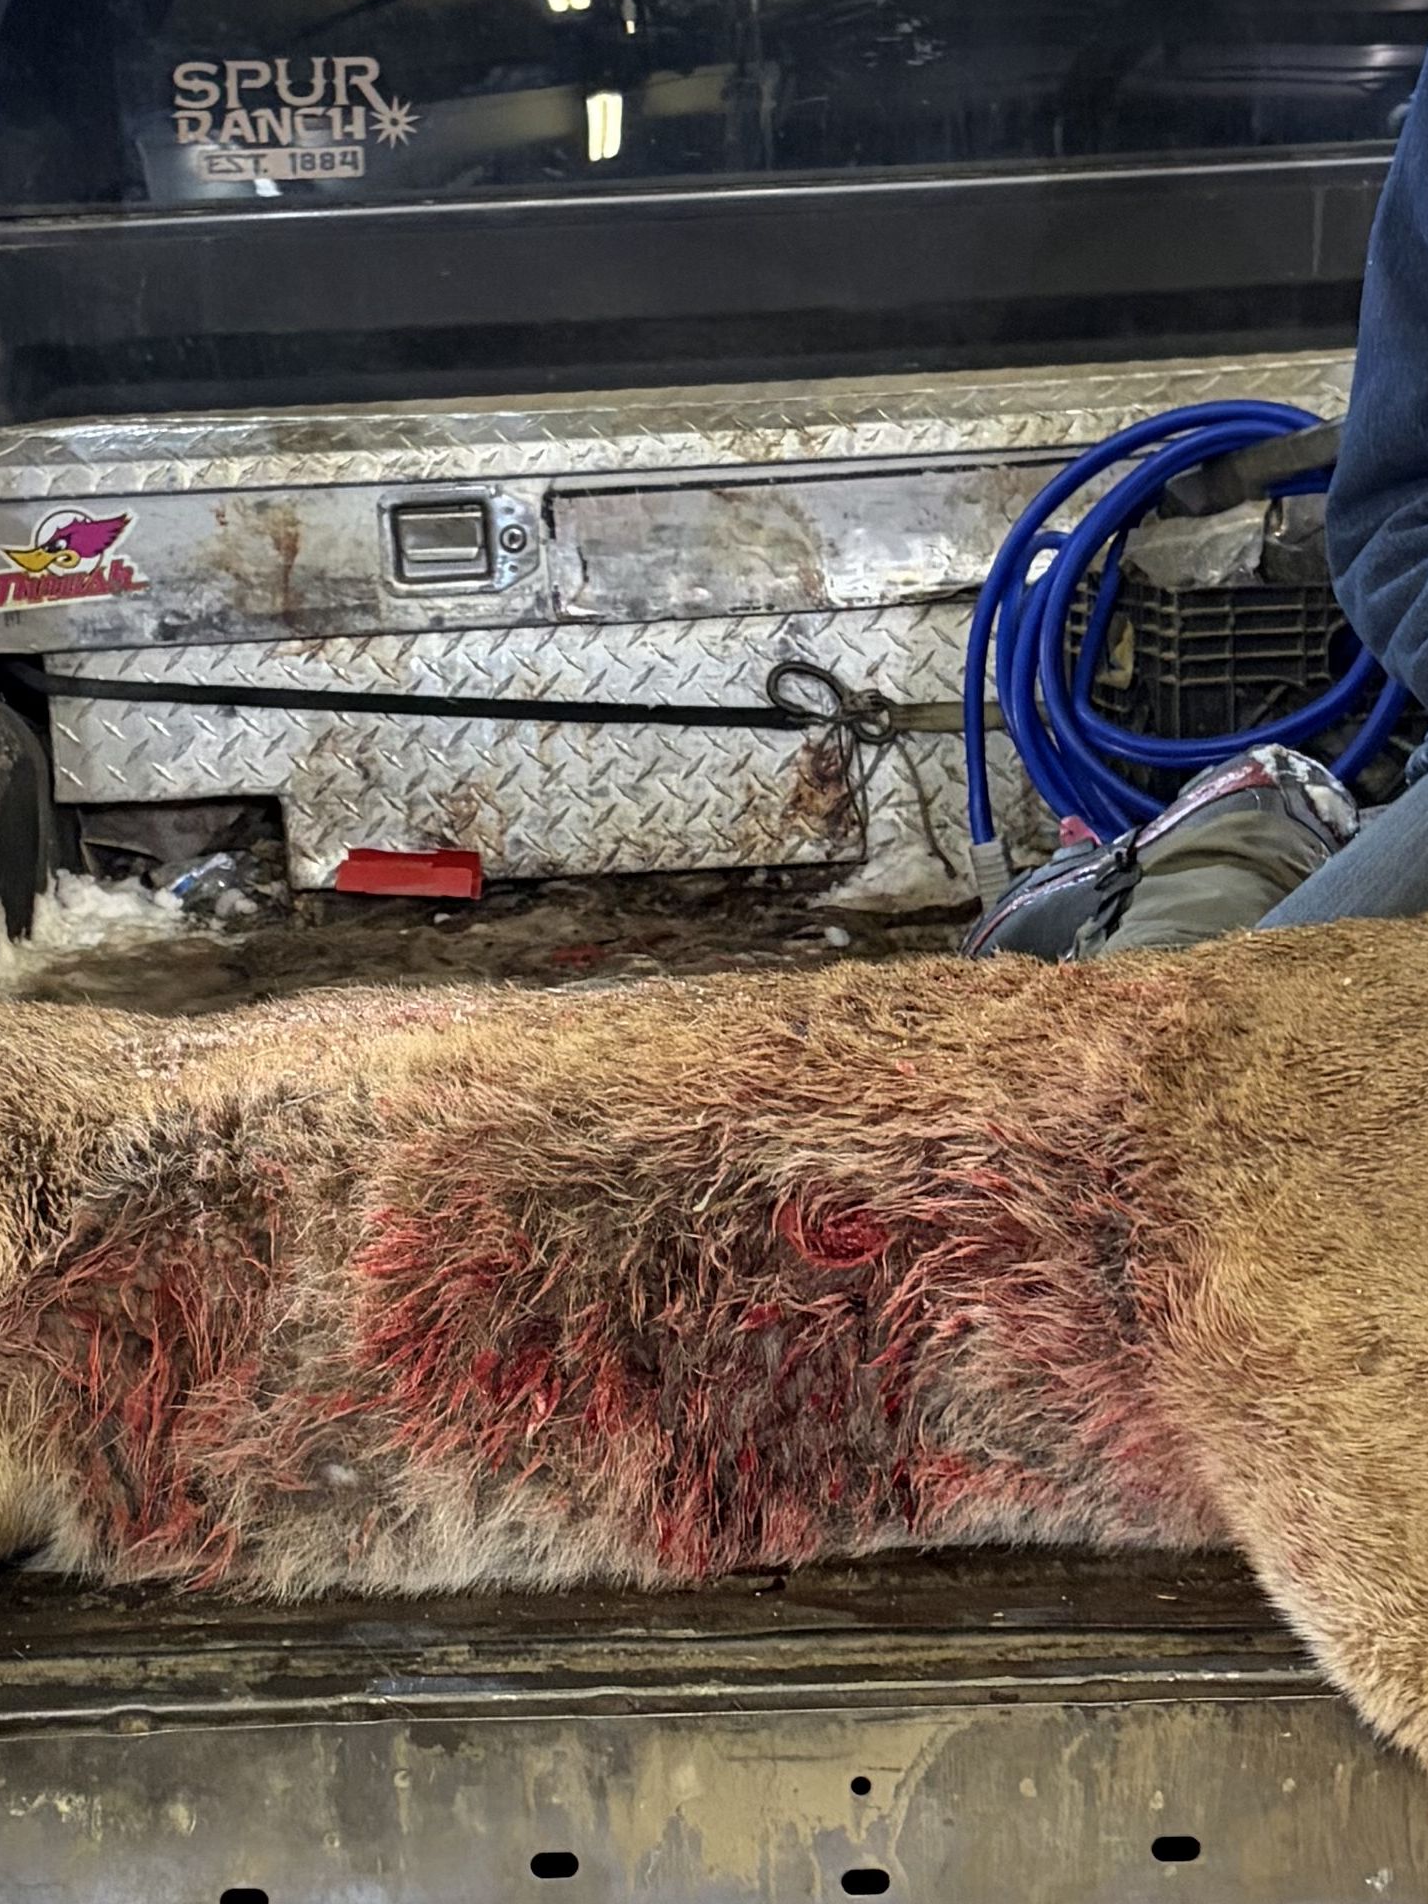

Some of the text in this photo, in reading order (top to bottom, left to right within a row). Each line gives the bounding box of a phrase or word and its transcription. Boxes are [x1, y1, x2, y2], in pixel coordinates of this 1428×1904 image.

[173, 56, 389, 110] SPUR
[171, 106, 366, 145] RANCH
[203, 151, 360, 175] EST. 1884
